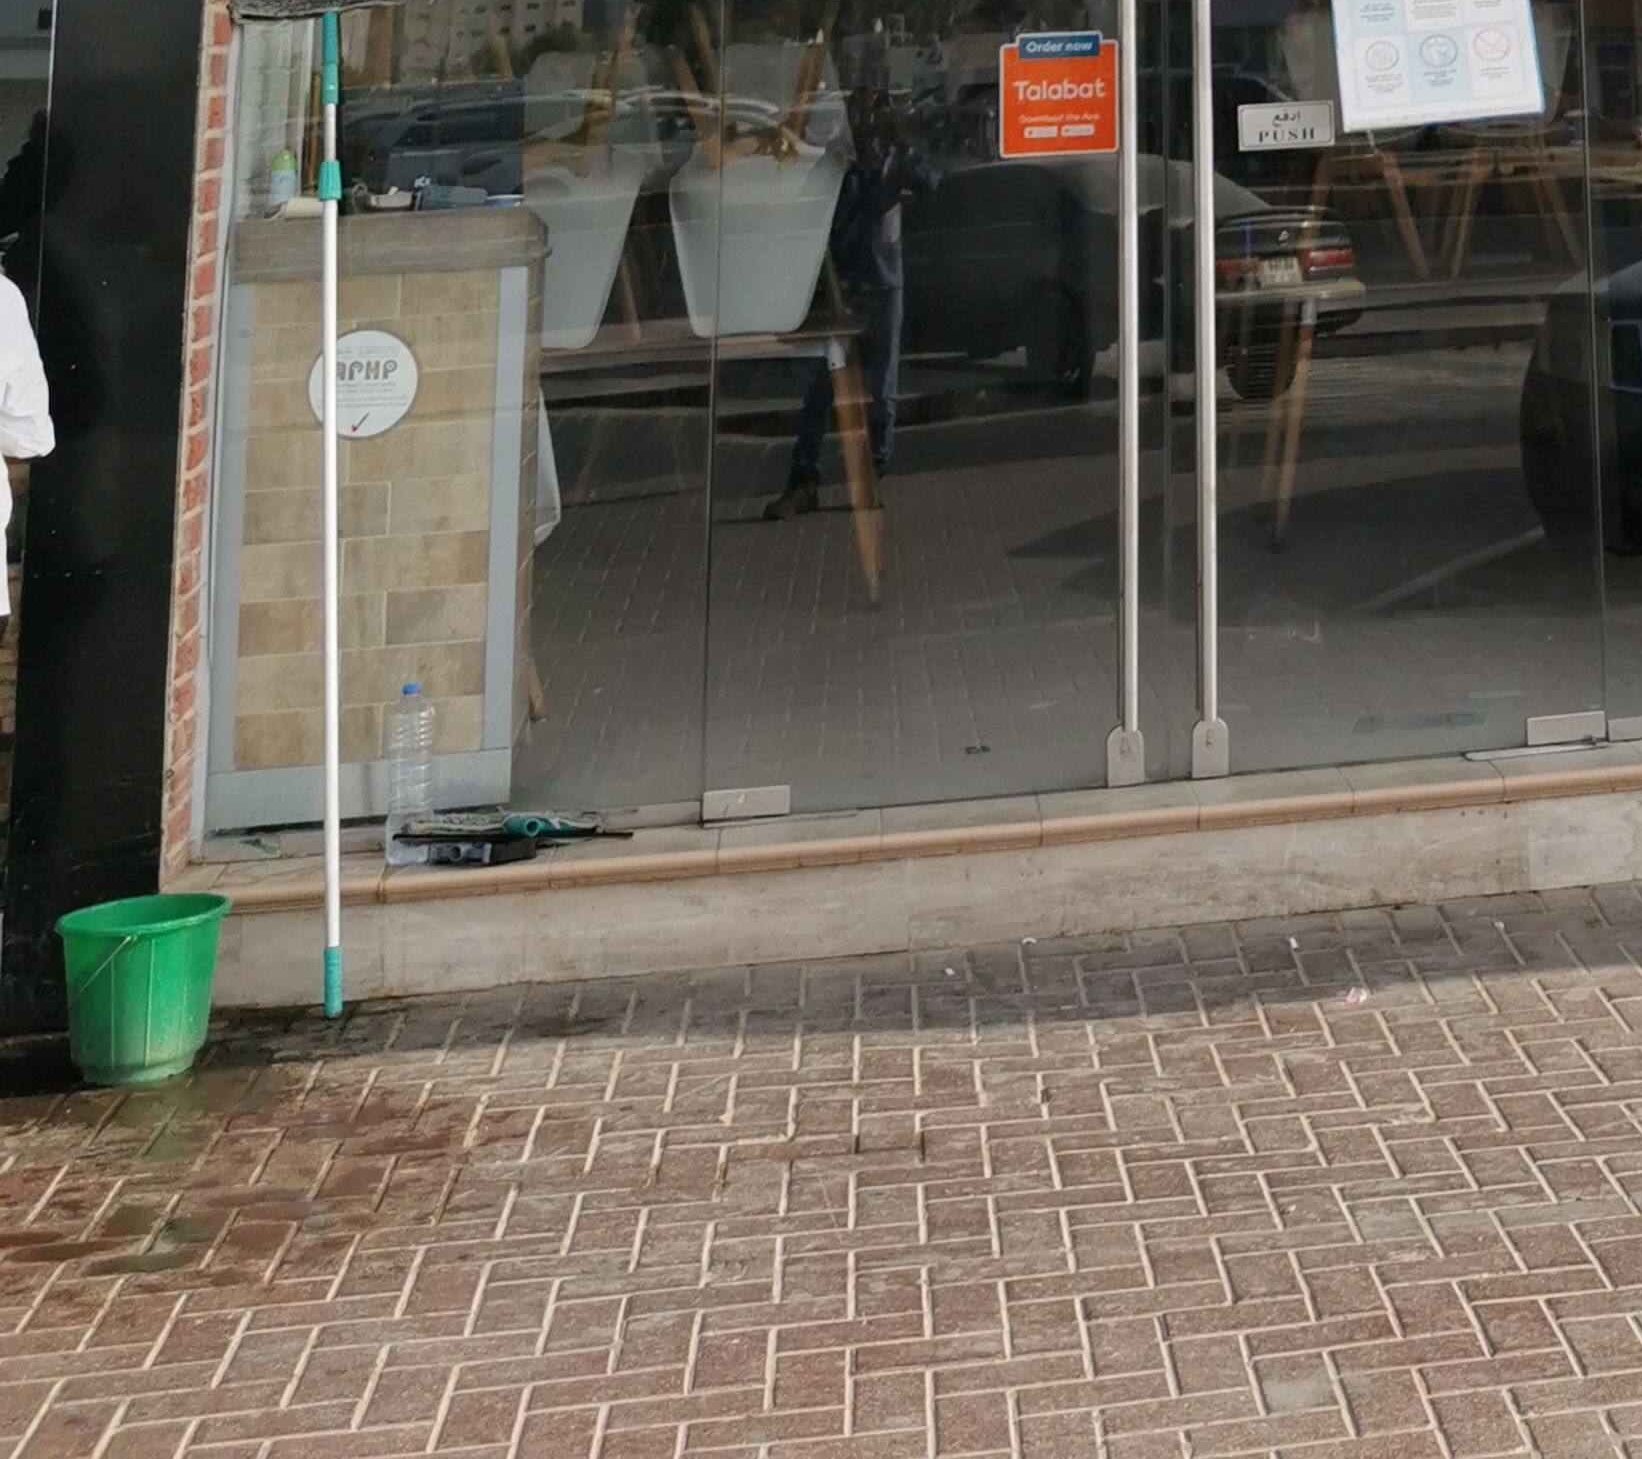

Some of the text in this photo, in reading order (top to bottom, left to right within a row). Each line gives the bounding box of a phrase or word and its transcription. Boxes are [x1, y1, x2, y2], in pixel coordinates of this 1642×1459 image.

[1026, 41, 1093, 53] Order now
[1012, 78, 1106, 102] Talabat
[1258, 127, 1315, 143] PUSH
